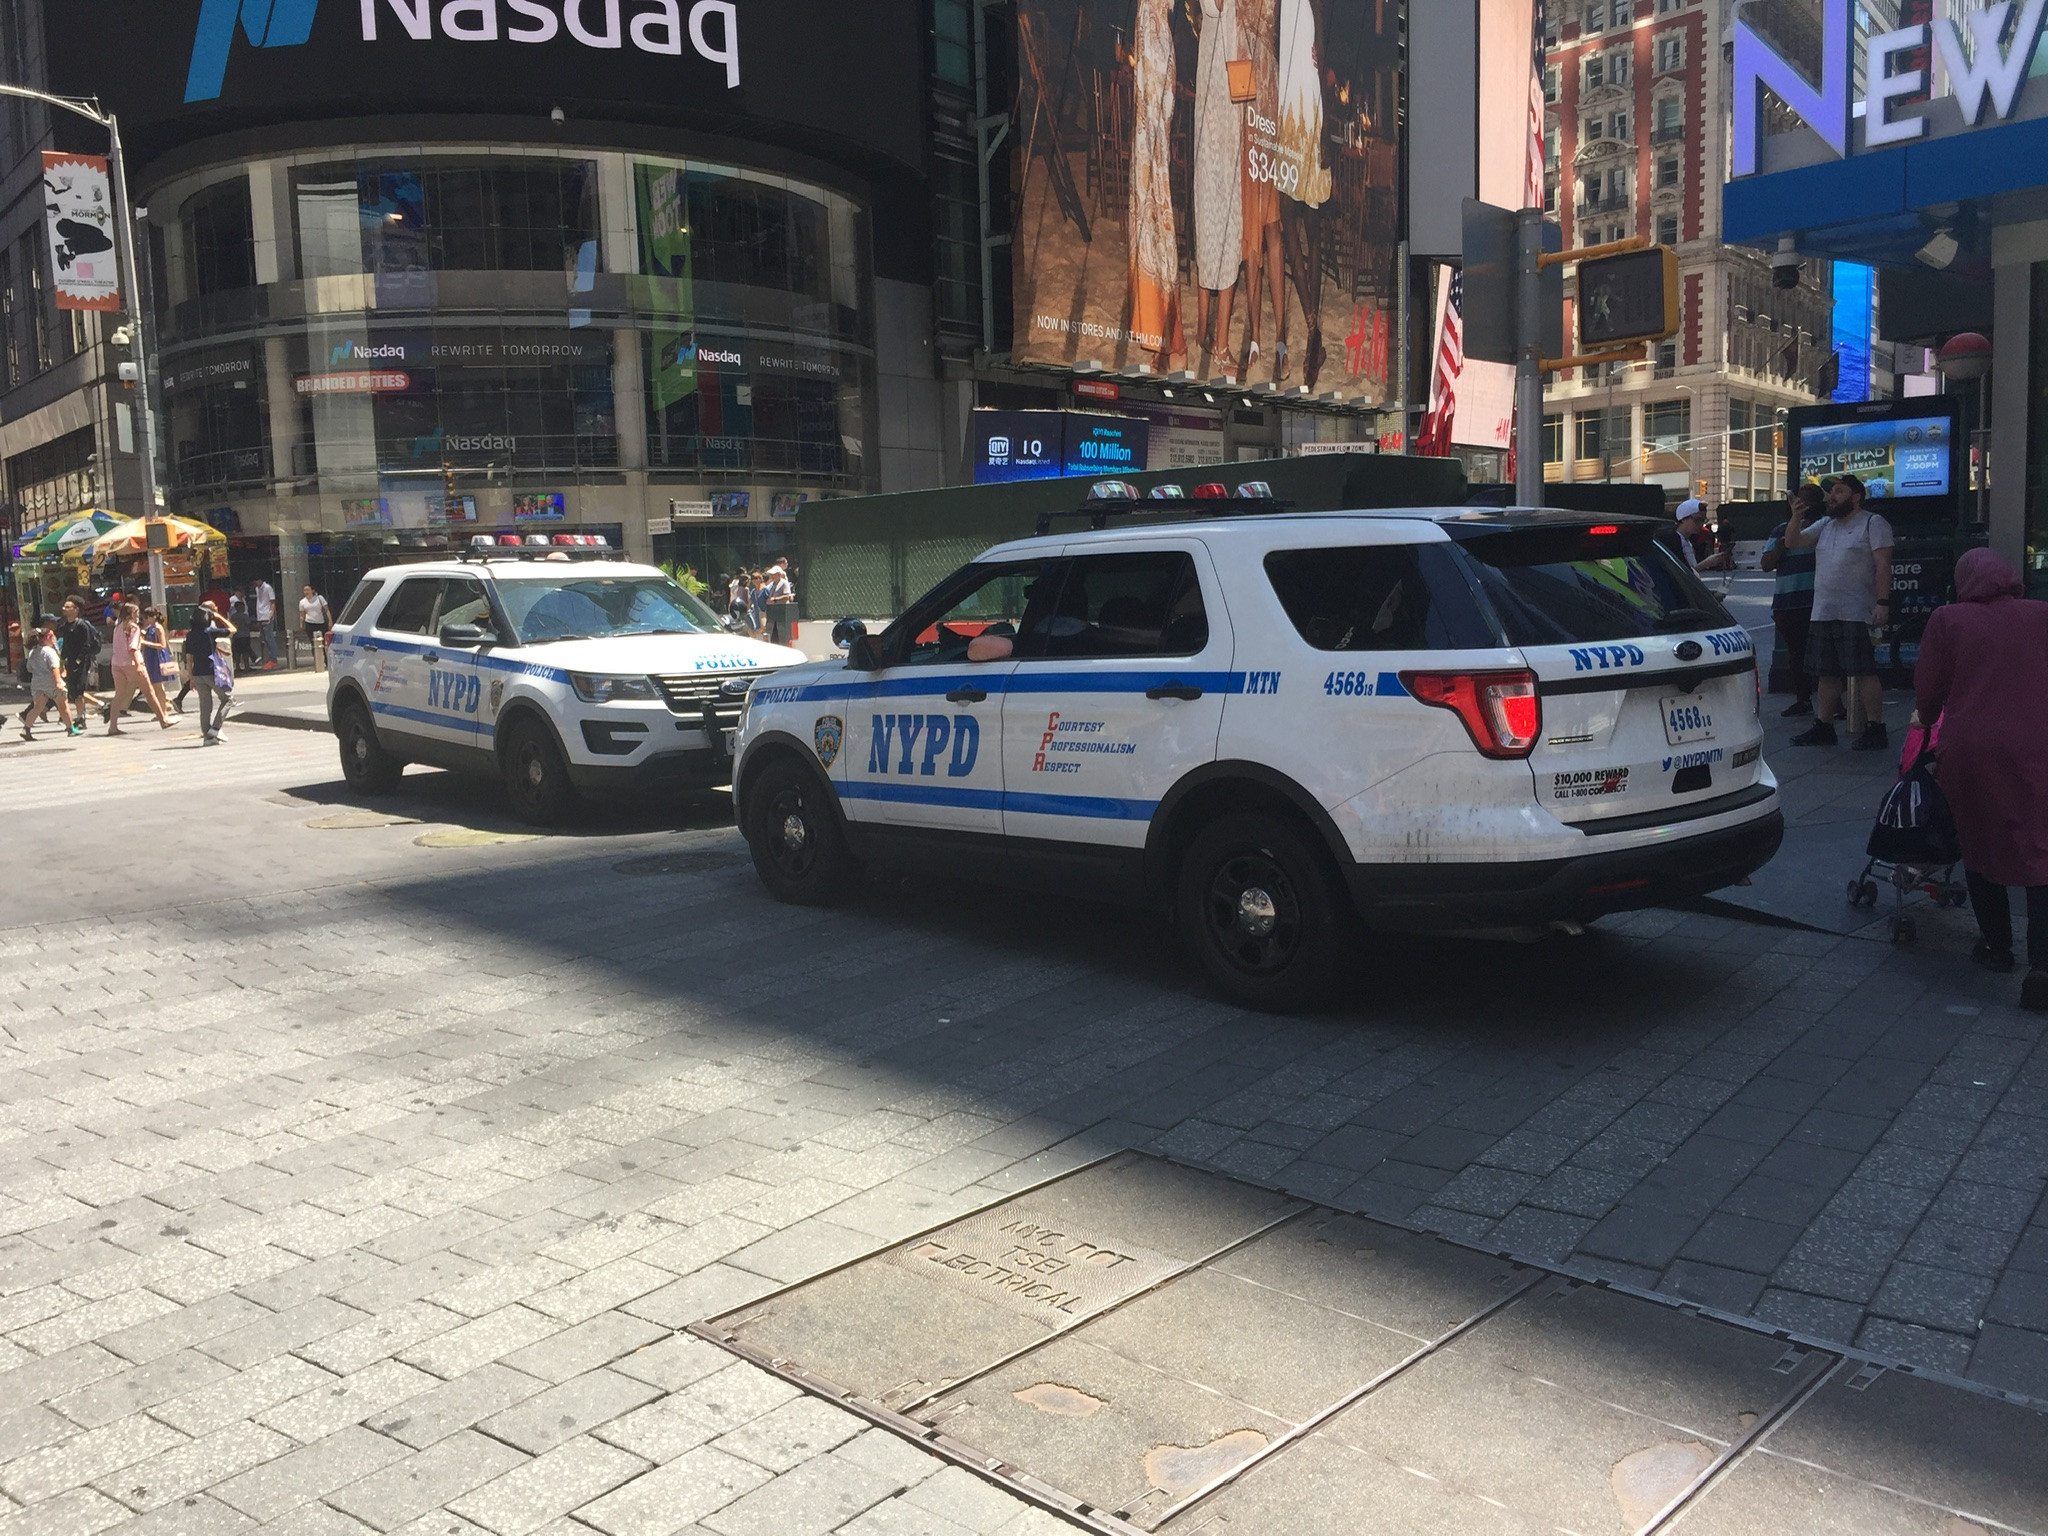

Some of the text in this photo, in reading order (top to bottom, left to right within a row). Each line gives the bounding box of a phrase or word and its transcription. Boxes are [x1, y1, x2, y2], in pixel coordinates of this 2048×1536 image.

[360, 0, 740, 89] Nasdaq
[1247, 105, 1276, 136] Dress
[1248, 145, 1299, 192] $34.99
[1037, 315, 1167, 348] NOW IN STORES AND AT HM.COM
[353, 344, 405, 359] Nasdaq
[431, 345, 583, 356] REWRITE TOMORROW
[698, 348, 741, 366] Nasdaq
[204, 360, 250, 375] TOMORROW
[759, 356, 798, 370] REWRITE
[296, 374, 406, 392] BRANDED CITIES
[446, 433, 516, 453] Nasdaq
[1079, 441, 1131, 461] 100 Million
[1304, 445, 1336, 453] PEDESTRIAN
[1351, 444, 1365, 452] ZONE
[1837, 447, 1886, 463] ETIHAD
[1907, 453, 1938, 462] JULY 3
[1905, 461, 1939, 470] 7:00PM
[1890, 563, 1922, 575] are
[695, 657, 758, 670] POLICE
[1569, 645, 1644, 671] NYPD
[523, 662, 555, 680] POLICE
[427, 669, 481, 714] NYPD
[1246, 671, 1281, 694] MTN
[763, 687, 799, 704] POLICE
[1048, 711, 1105, 733] COURTESY
[868, 714, 980, 777] NYPD
[1040, 732, 1136, 754] PROFESSIONALISM
[1032, 753, 1081, 773] RESPECT
[1673, 748, 1724, 769] @NYPDMTN
[1554, 771, 1592, 786] $10,000
[1594, 767, 1629, 781] REWARD
[1554, 789, 1569, 799] CALL
[1571, 788, 1588, 797] 1-800
[1879, 780, 1922, 829] GAP
[1000, 1220, 1065, 1246] NYC
